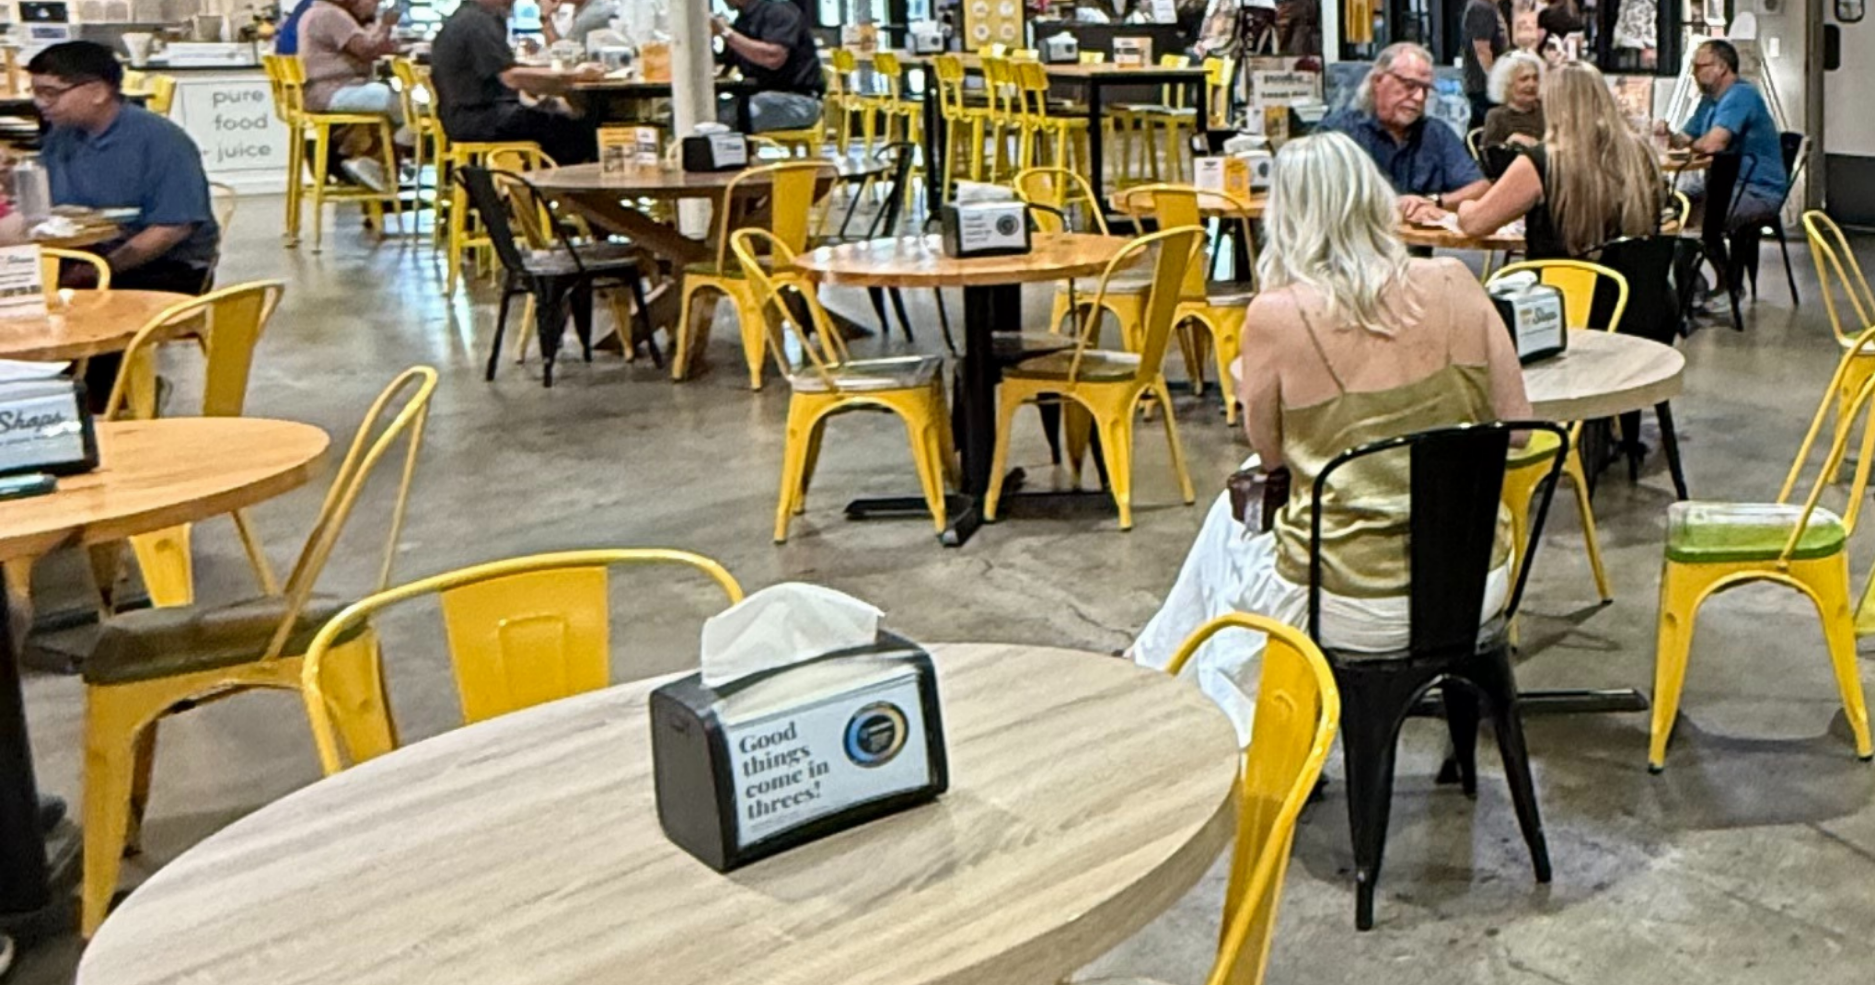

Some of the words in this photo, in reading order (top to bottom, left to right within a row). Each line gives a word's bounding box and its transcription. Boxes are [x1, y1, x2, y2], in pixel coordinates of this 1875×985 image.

[213, 90, 264, 108] pure
[214, 113, 268, 131] food
[216, 142, 271, 163] juice
[739, 721, 798, 754] Good
[743, 744, 811, 777] things
[745, 769, 802, 798] come
[808, 760, 830, 779] in
[747, 780, 822, 819] threes!
